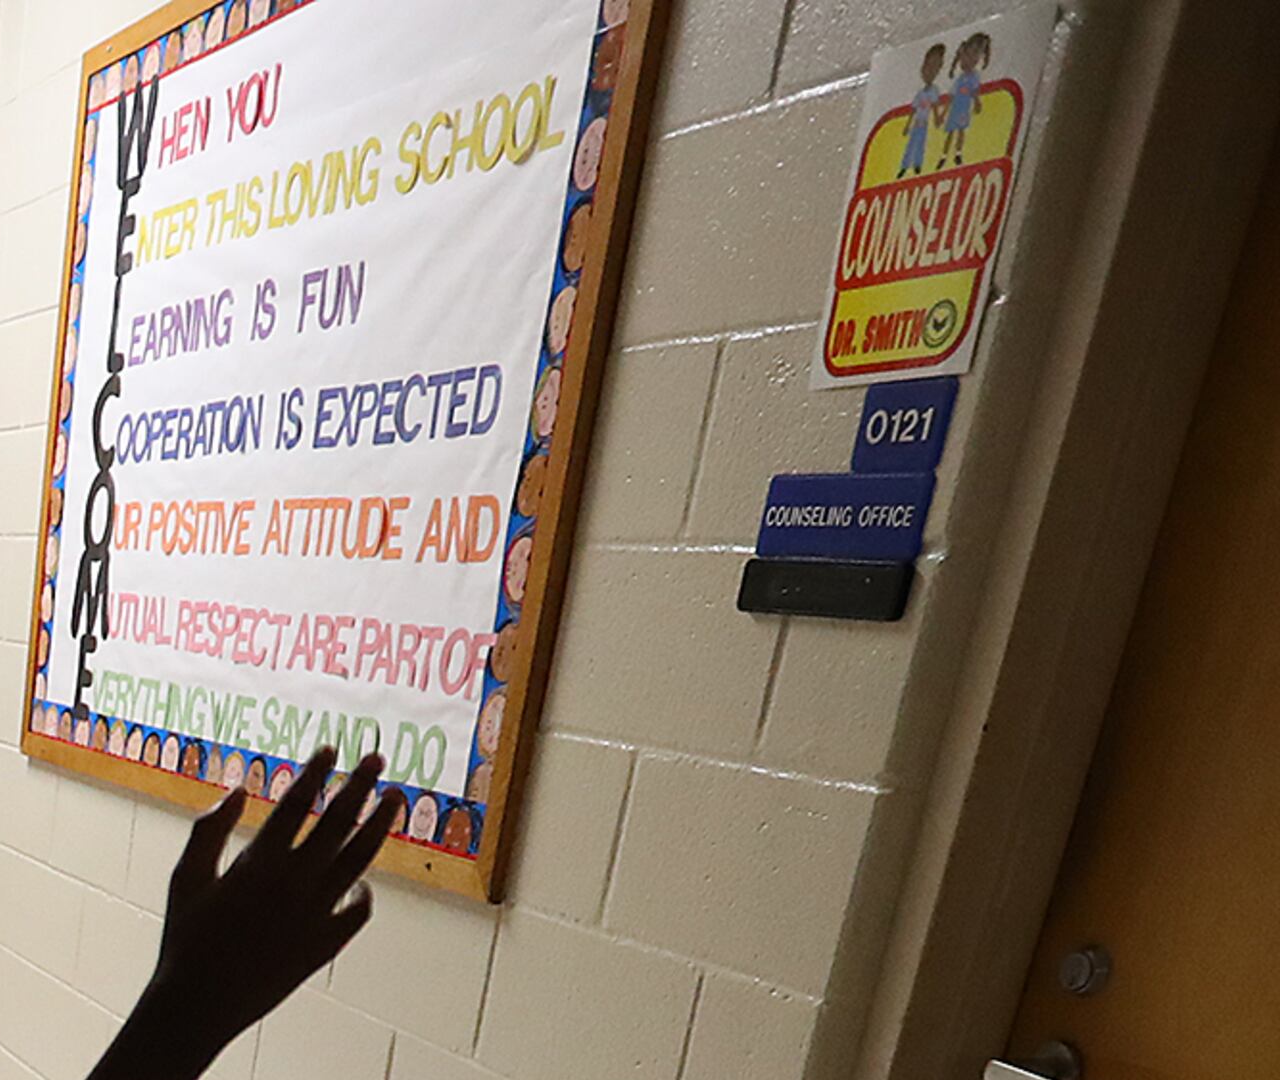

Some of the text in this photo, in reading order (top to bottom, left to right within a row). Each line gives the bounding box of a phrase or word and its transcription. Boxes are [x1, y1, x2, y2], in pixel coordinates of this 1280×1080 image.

[227, 62, 282, 143] YOU
[206, 175, 264, 247] THIS
[268, 136, 382, 229] LOVING
[395, 74, 565, 195] SCHOOL
[842, 167, 1004, 281] COUNSELOR
[250, 278, 277, 341] IS
[297, 261, 366, 334] FUN
[831, 308, 927, 358] DR. SMITH
[275, 386, 304, 451] IS
[312, 363, 503, 449] EXPECTED
[145, 499, 256, 556] POSITIVE
[262, 496, 411, 561] ATTITUDE
[415, 493, 502, 564] AND
[766, 504, 915, 528] COUNSELING OFFICE
[174, 600, 291, 672] RESPECT
[287, 612, 356, 679] ARE
[354, 616, 445, 692] PART
[439, 627, 500, 701] OF
[208, 689, 259, 749] WE
[261, 696, 313, 760] SAY
[312, 709, 381, 774] AND
[389, 719, 448, 790] DO
